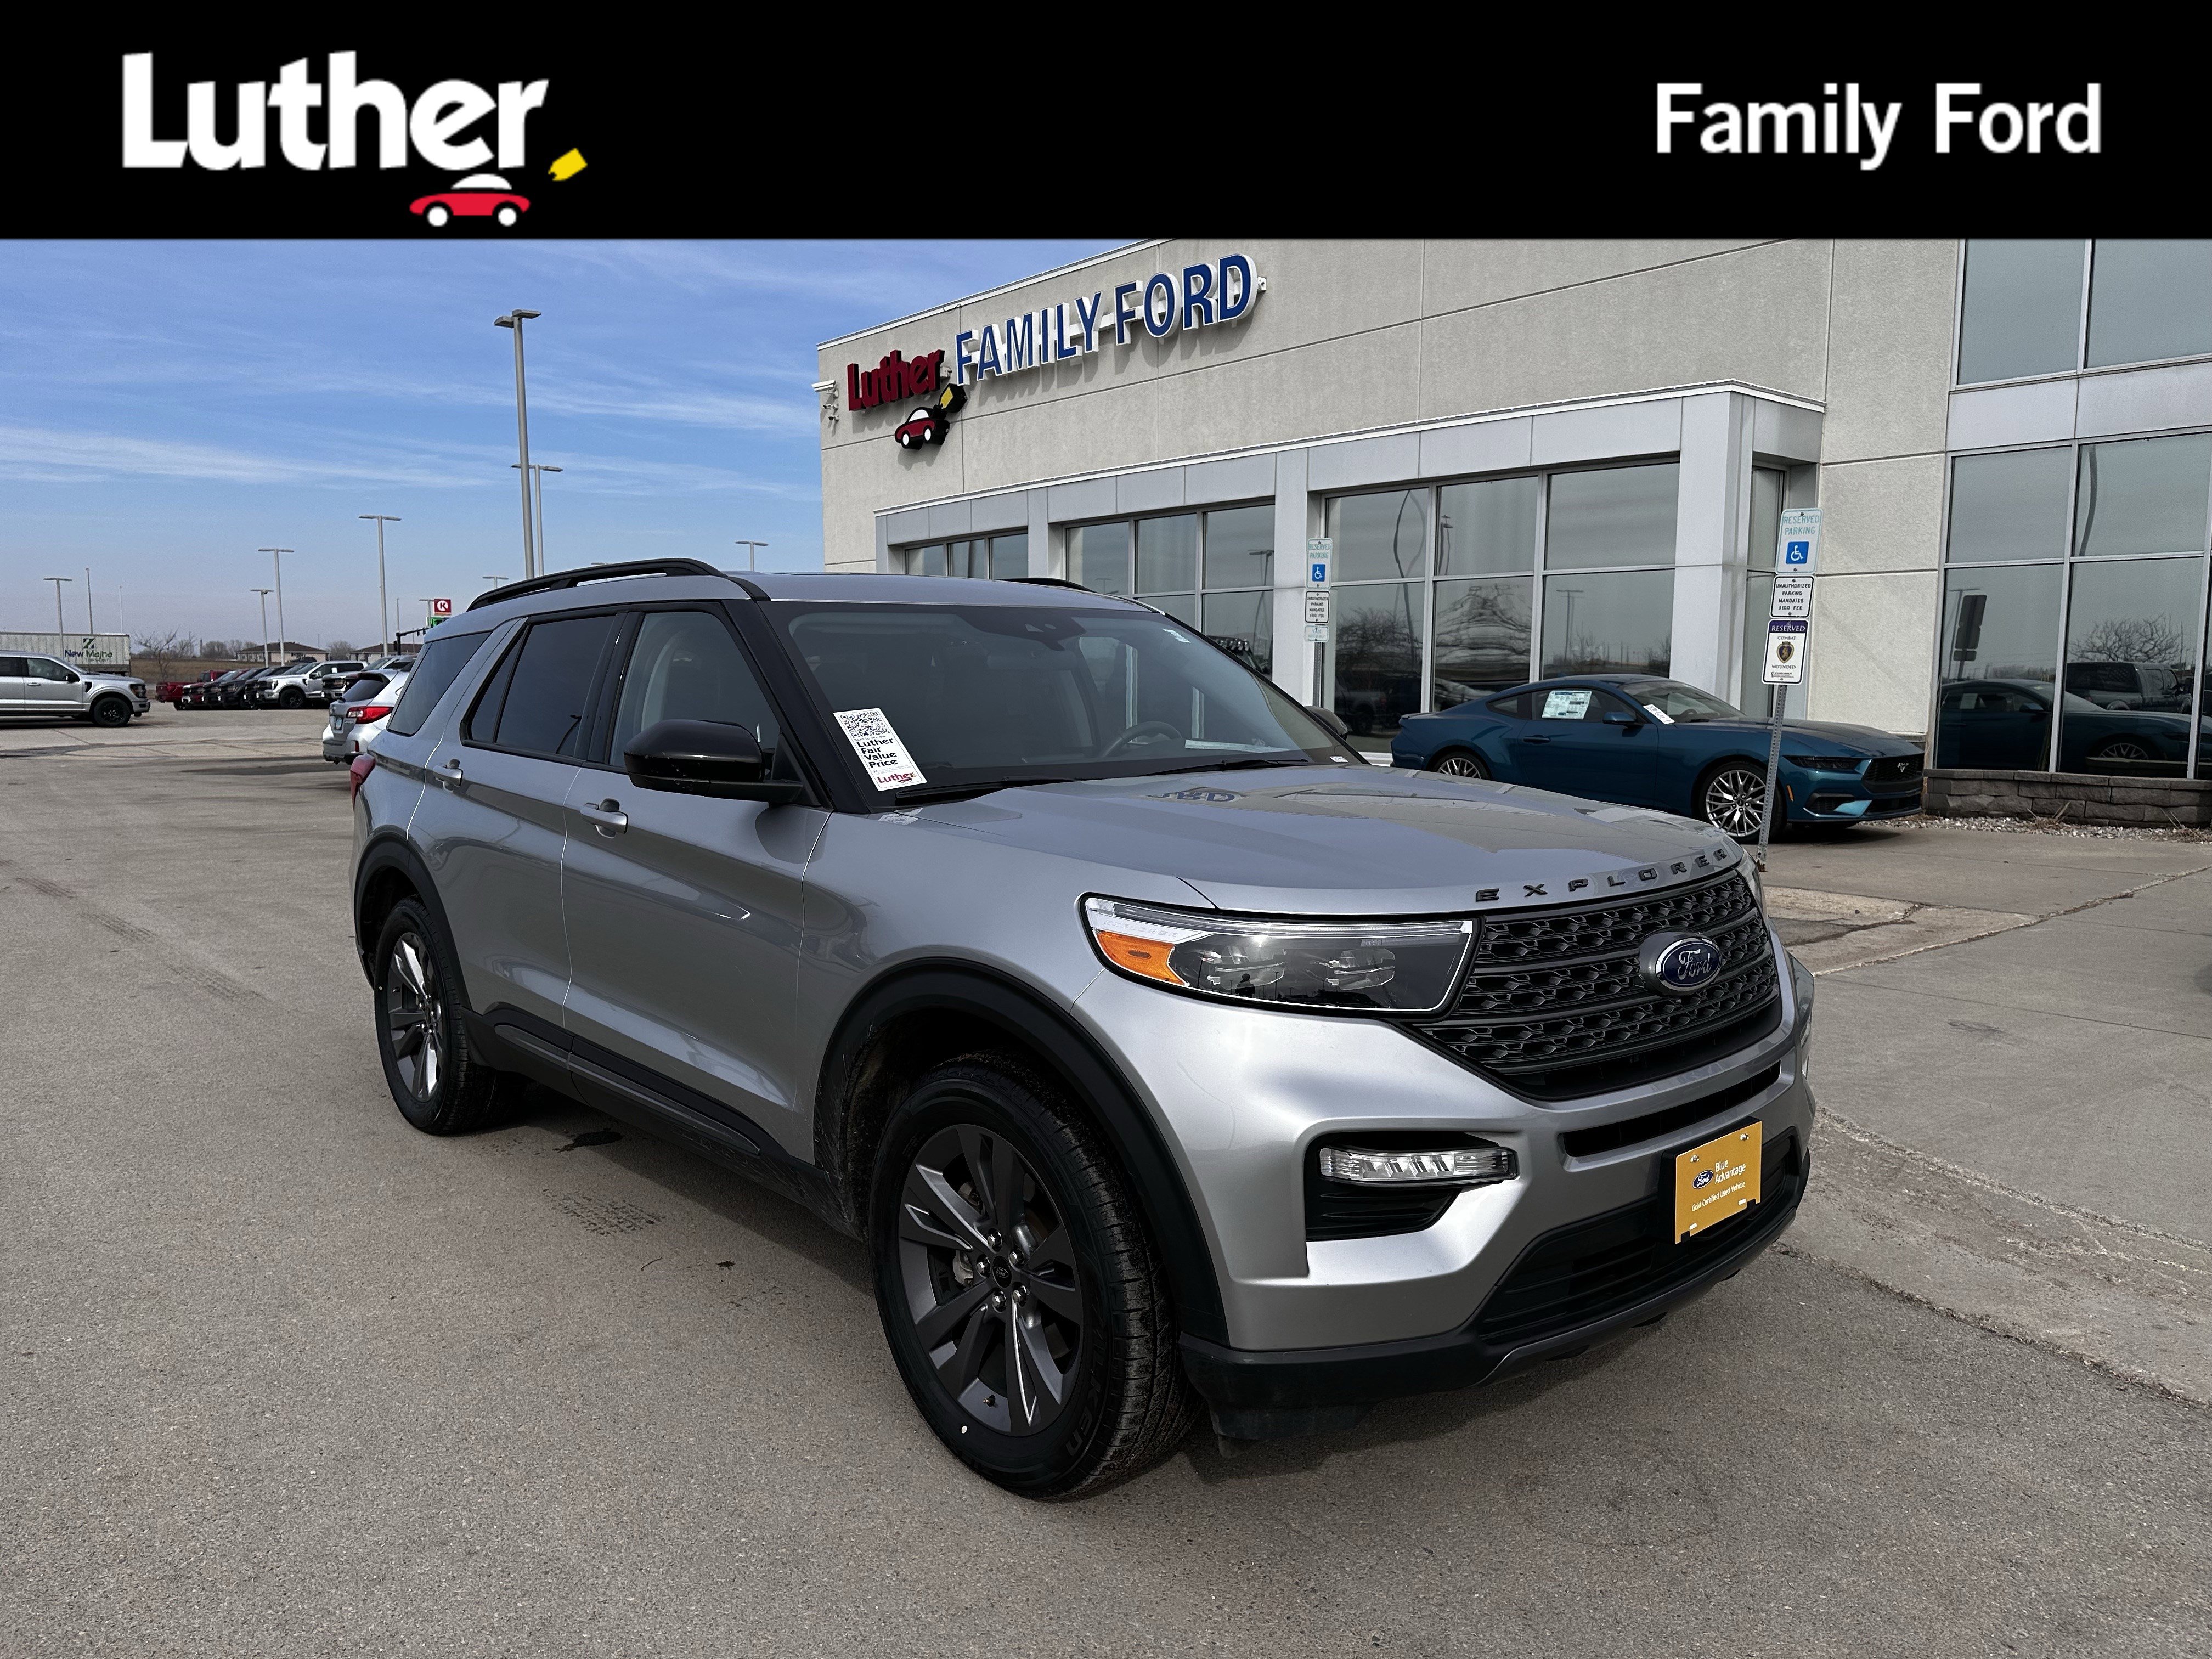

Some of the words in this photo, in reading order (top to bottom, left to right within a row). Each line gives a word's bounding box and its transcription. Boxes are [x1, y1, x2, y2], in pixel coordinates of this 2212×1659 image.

[955, 291, 1103, 386] FAMILY
[1114, 253, 1258, 346] FORD
[847, 349, 946, 412] Luther
[1784, 515, 1820, 524] RESERVED
[1784, 526, 1815, 535] PARKING
[64, 649, 84, 658] New
[856, 738, 893, 747] Luther
[868, 760, 898, 768] Price
[877, 772, 913, 783] Luther
[1475, 848, 1729, 902] EXPLORER
[1676, 948, 1713, 981] Ford
[1715, 1160, 1729, 1173] Blue
[1696, 1172, 1710, 1187] Ford
[1714, 1164, 1746, 1185] Advantage
[1691, 1200, 1702, 1212] Gold
[1702, 1191, 1719, 1206] Certified
[1720, 1187, 1730, 1198] Used
[1731, 1181, 1746, 1193] Vehicle
